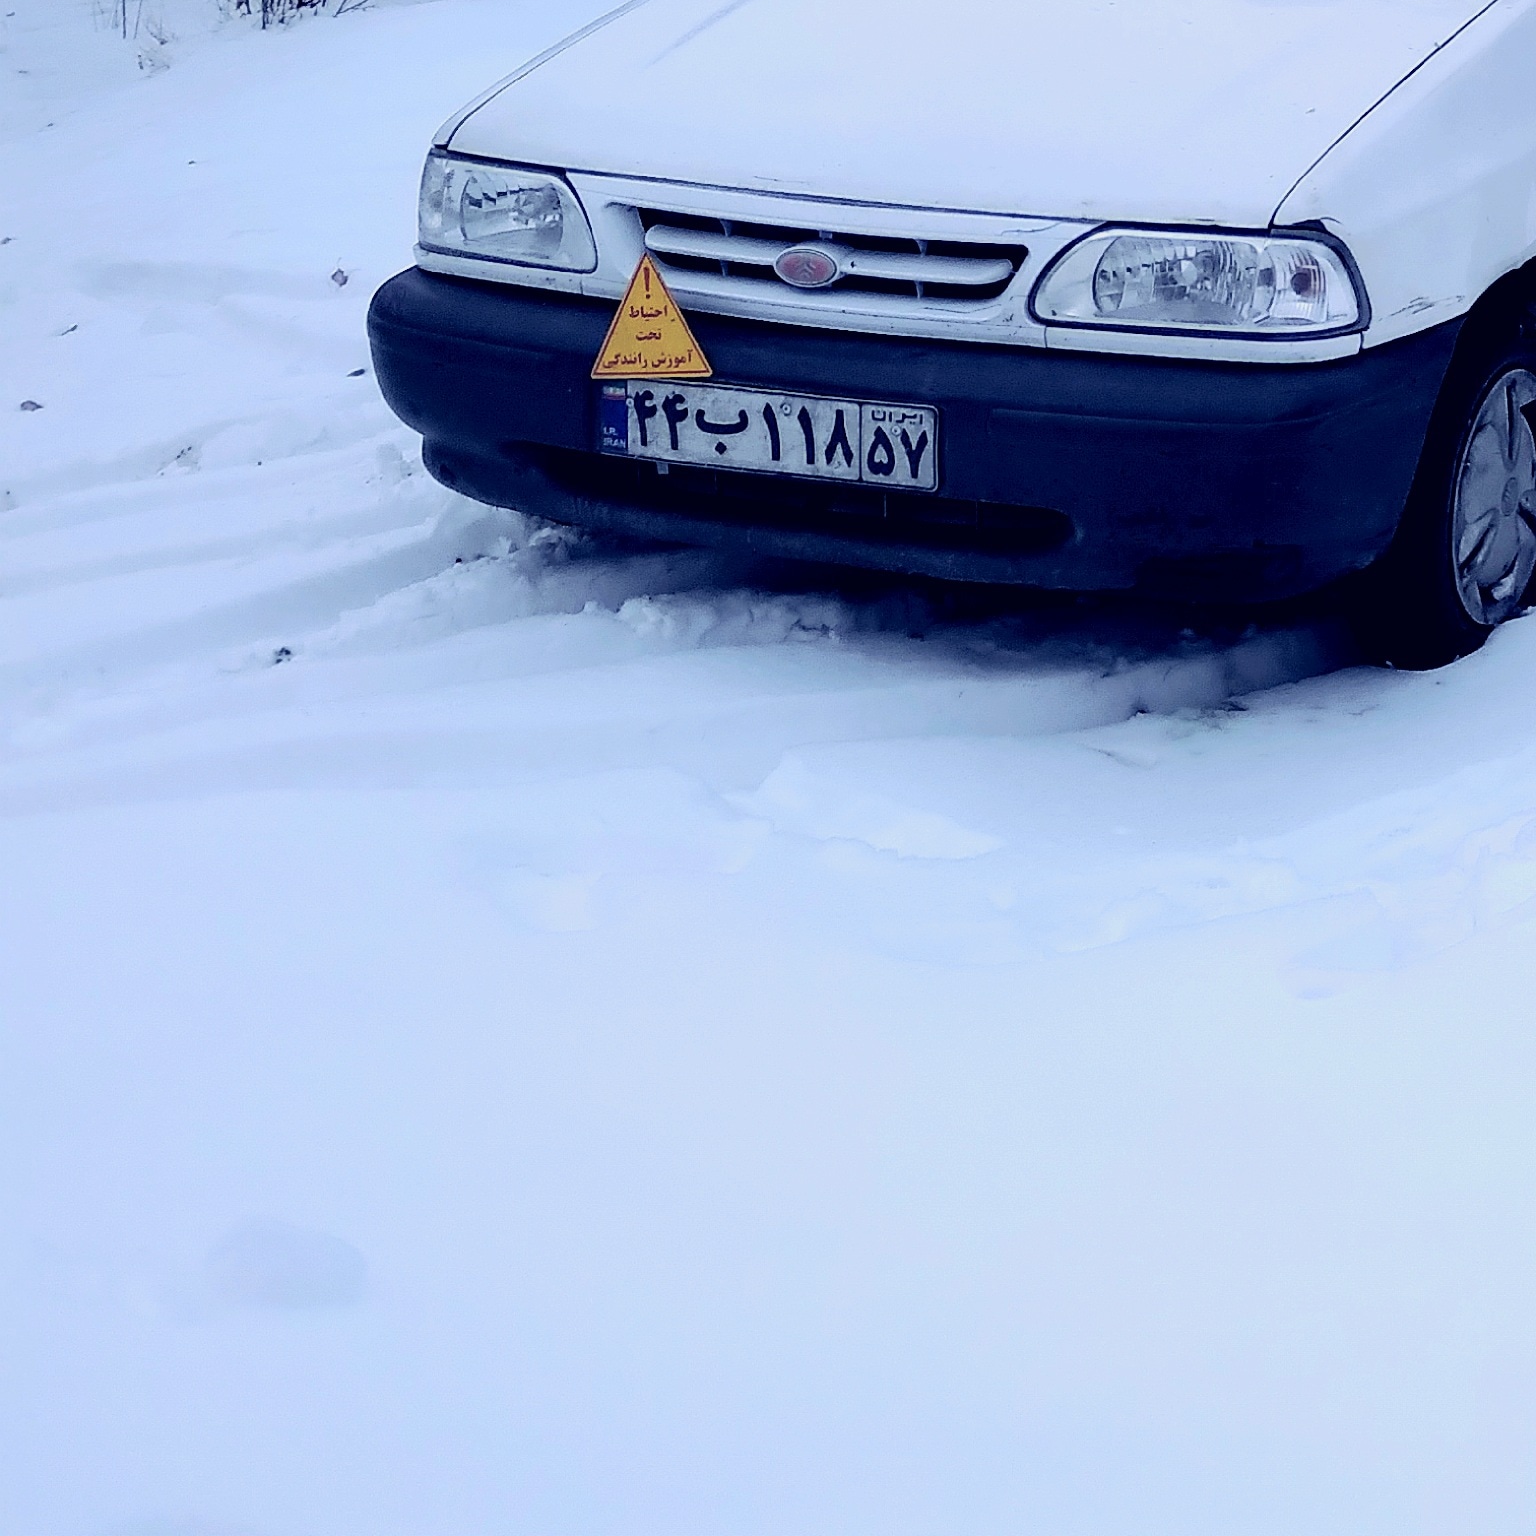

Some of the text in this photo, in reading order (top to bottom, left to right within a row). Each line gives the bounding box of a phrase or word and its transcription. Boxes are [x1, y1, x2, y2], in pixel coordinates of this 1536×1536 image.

[629, 305, 668, 322] احتیاط
[635, 328, 662, 342] تحت
[602, 349, 694, 369] آموزش رانندگی
[871, 409, 924, 425] ایران
[602, 437, 626, 449] IRAN
[867, 425, 929, 479] ۵۷
